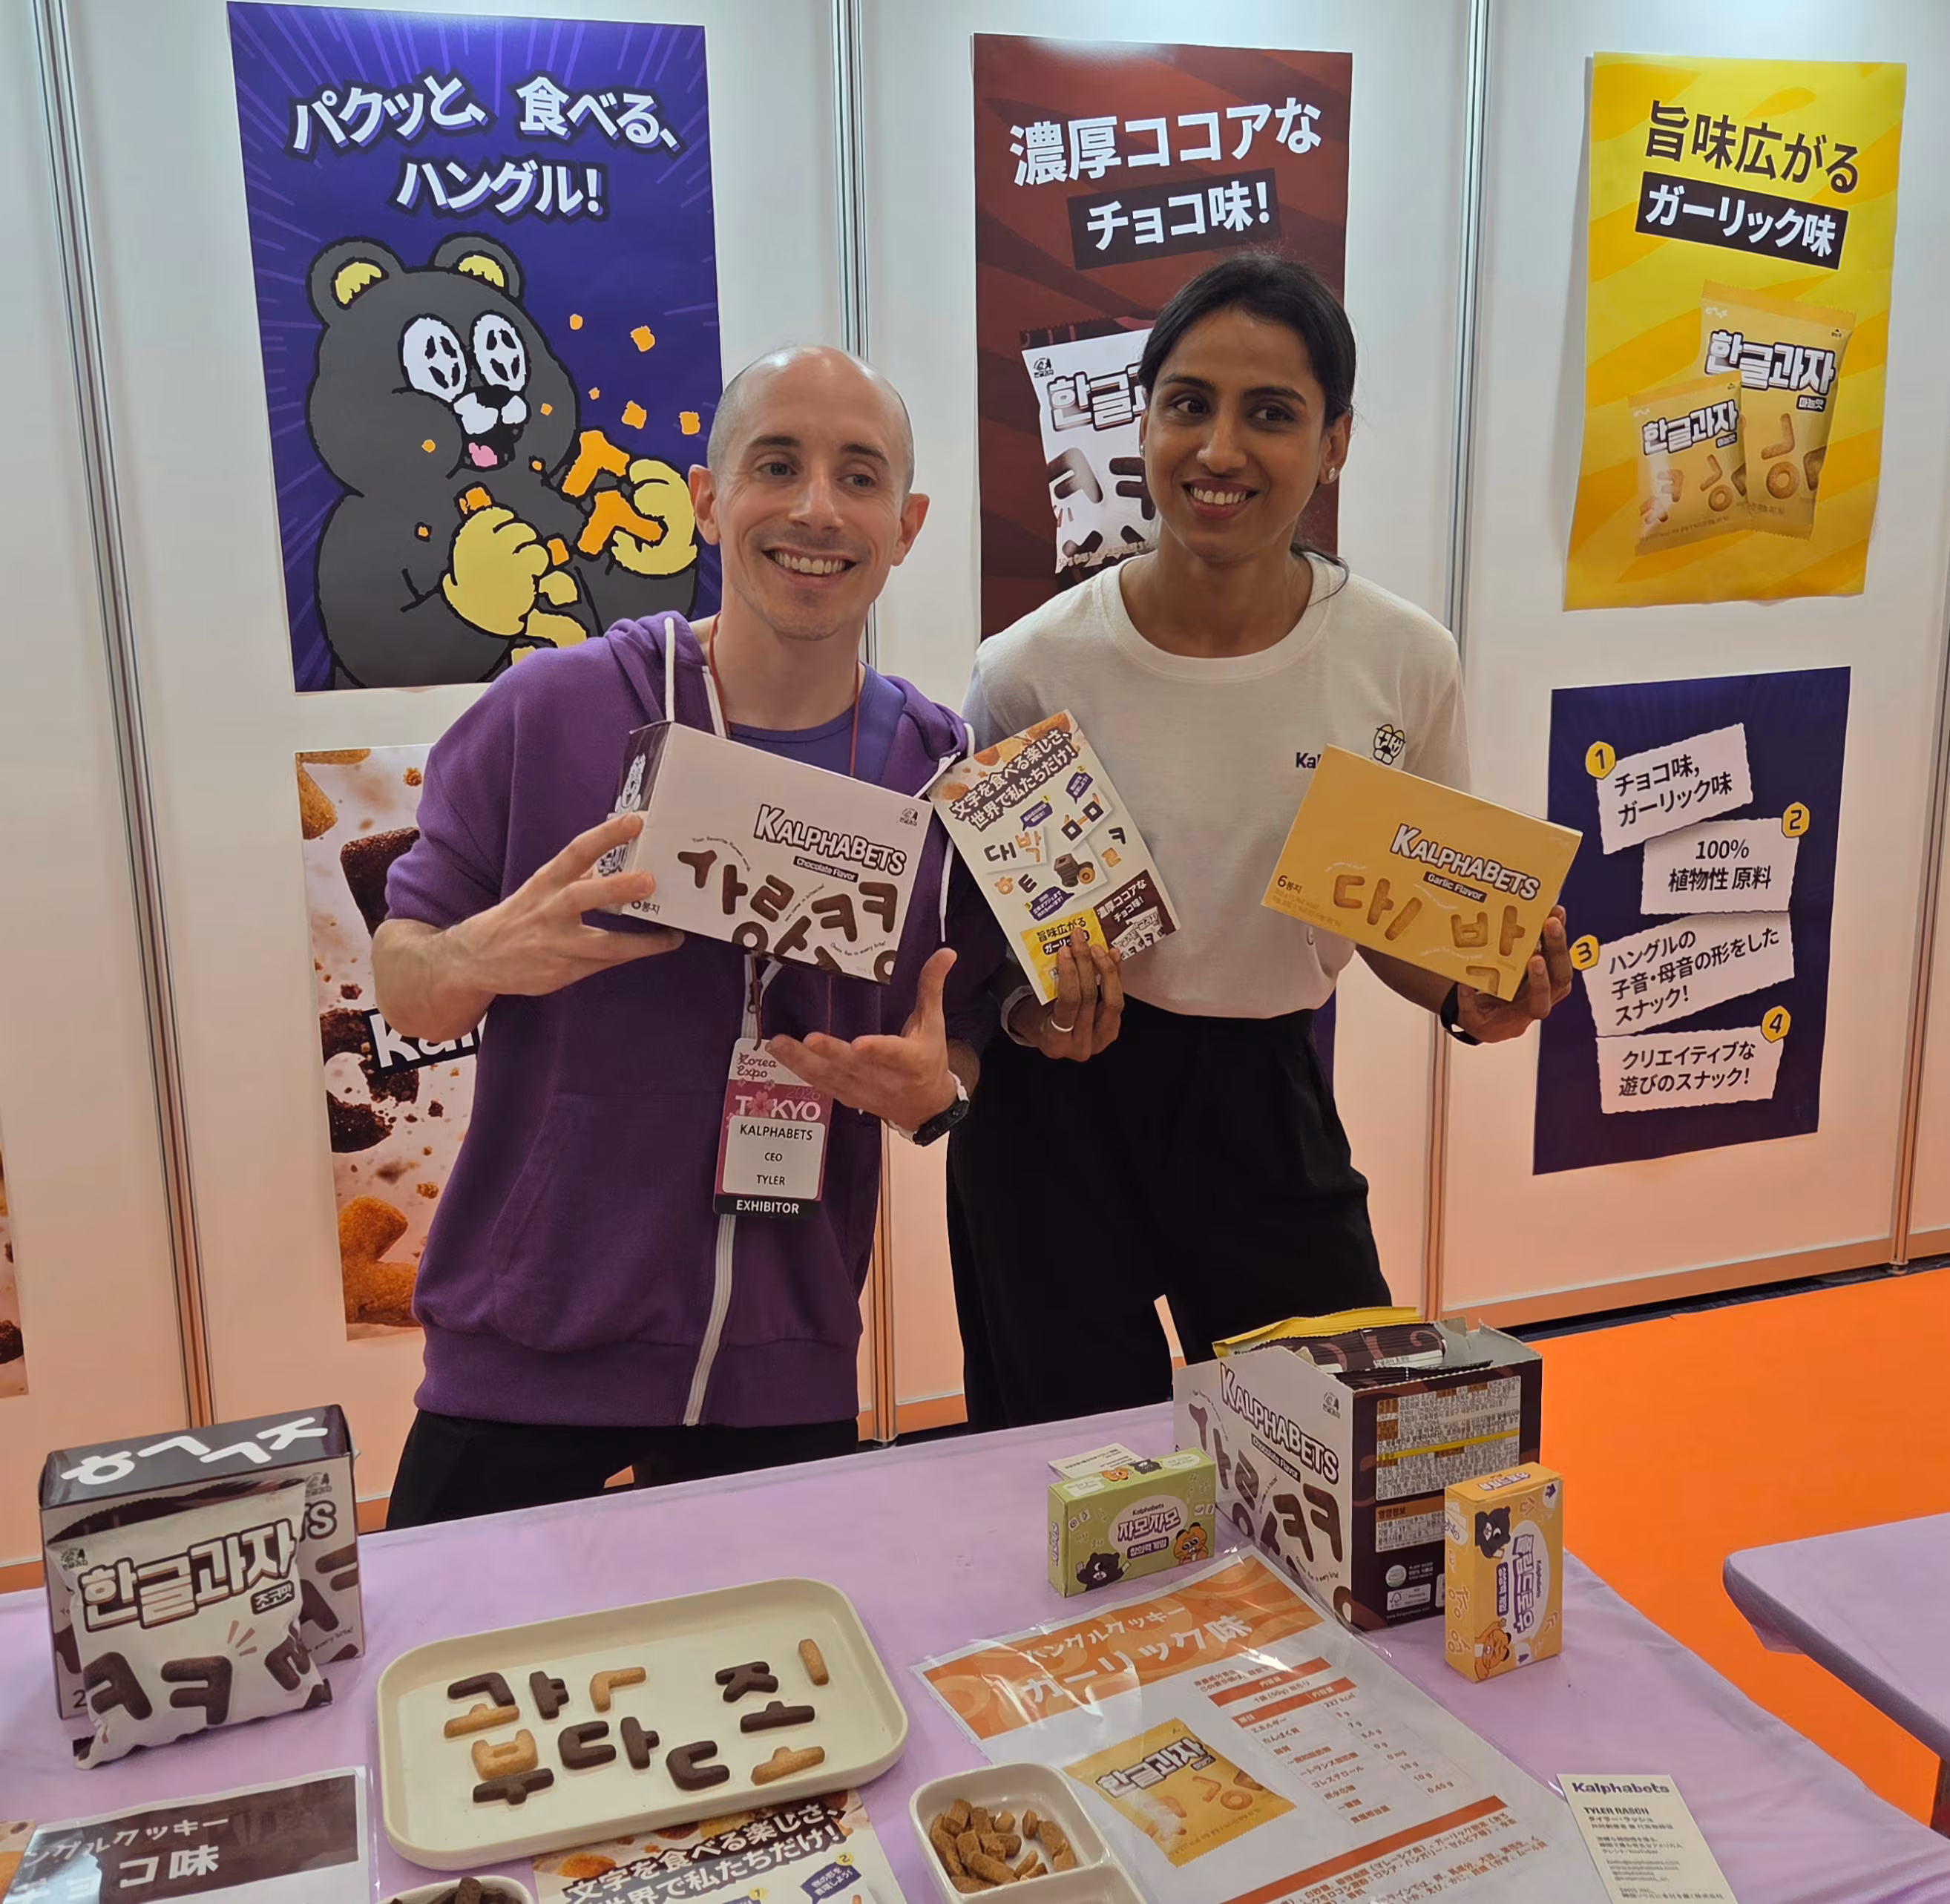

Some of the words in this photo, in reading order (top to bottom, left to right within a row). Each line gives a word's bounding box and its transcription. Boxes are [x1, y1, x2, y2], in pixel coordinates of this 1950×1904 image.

[294, 75, 490, 152] パクッと、
[516, 76, 680, 151] 食べる、
[1009, 97, 1322, 186] 濃厚ココアな
[1645, 99, 1859, 193] 旨味広がる
[396, 160, 601, 215] ハングル!
[1087, 181, 1270, 251] チョコ味!
[1645, 184, 1836, 257] ガーリック味
[1704, 329, 1836, 395] 한글과자
[1642, 399, 1740, 456] 한글과자
[951, 730, 1072, 818] 文字を食べる楽しさ、
[1595, 749, 1605, 769] 1
[969, 744, 1076, 830] 世界で私たちだけ!
[1618, 772, 1733, 827] ガーリック味
[754, 804, 907, 876] KALPHABETS
[1790, 810, 1802, 830] 2
[1390, 824, 1541, 901] KALPHABETS
[1695, 839, 1749, 859] 100%
[796, 858, 833, 875] Chocolate
[833, 867, 856, 882] Flavor
[1427, 873, 1454, 891] Garlic
[1454, 882, 1483, 901] Flavor
[1577, 942, 1592, 963] 3
[1609, 931, 1695, 974] ハングルの
[1611, 928, 1779, 1001] 子音・母音の形をした
[1615, 985, 1689, 1025] スナック!
[1770, 1014, 1783, 1033] 4
[737, 1052, 777, 1068] Korea
[737, 1066, 768, 1079] Expo
[1623, 1041, 1756, 1069] クリエイティブな
[1619, 1068, 1749, 1096] 遊びのスナック!
[735, 1095, 821, 1122] TKYO
[741, 1124, 813, 1140] KALPHABETS
[765, 1152, 783, 1162] CEO
[757, 1175, 785, 1186] TYLER
[736, 1200, 799, 1214] EXHIBITOR
[1219, 1362, 1339, 1485] KALPHABETS
[1253, 1437, 1279, 1465] Chocolate
[1132, 1503, 1164, 1517] Kalphabets
[79, 1518, 297, 1632] 한글과자
[1025, 1606, 1186, 1659] ハングルクッキー
[1021, 1615, 1253, 1703] ガーリック味
[1095, 1737, 1208, 1799] 한글과자
[1311, 1765, 1365, 1788] コレステロール
[1572, 1782, 1670, 1795] Kalphabets
[1583, 1807, 1615, 1815] TYLER
[567, 1804, 839, 1904] 文字を食べる楽しさ、
